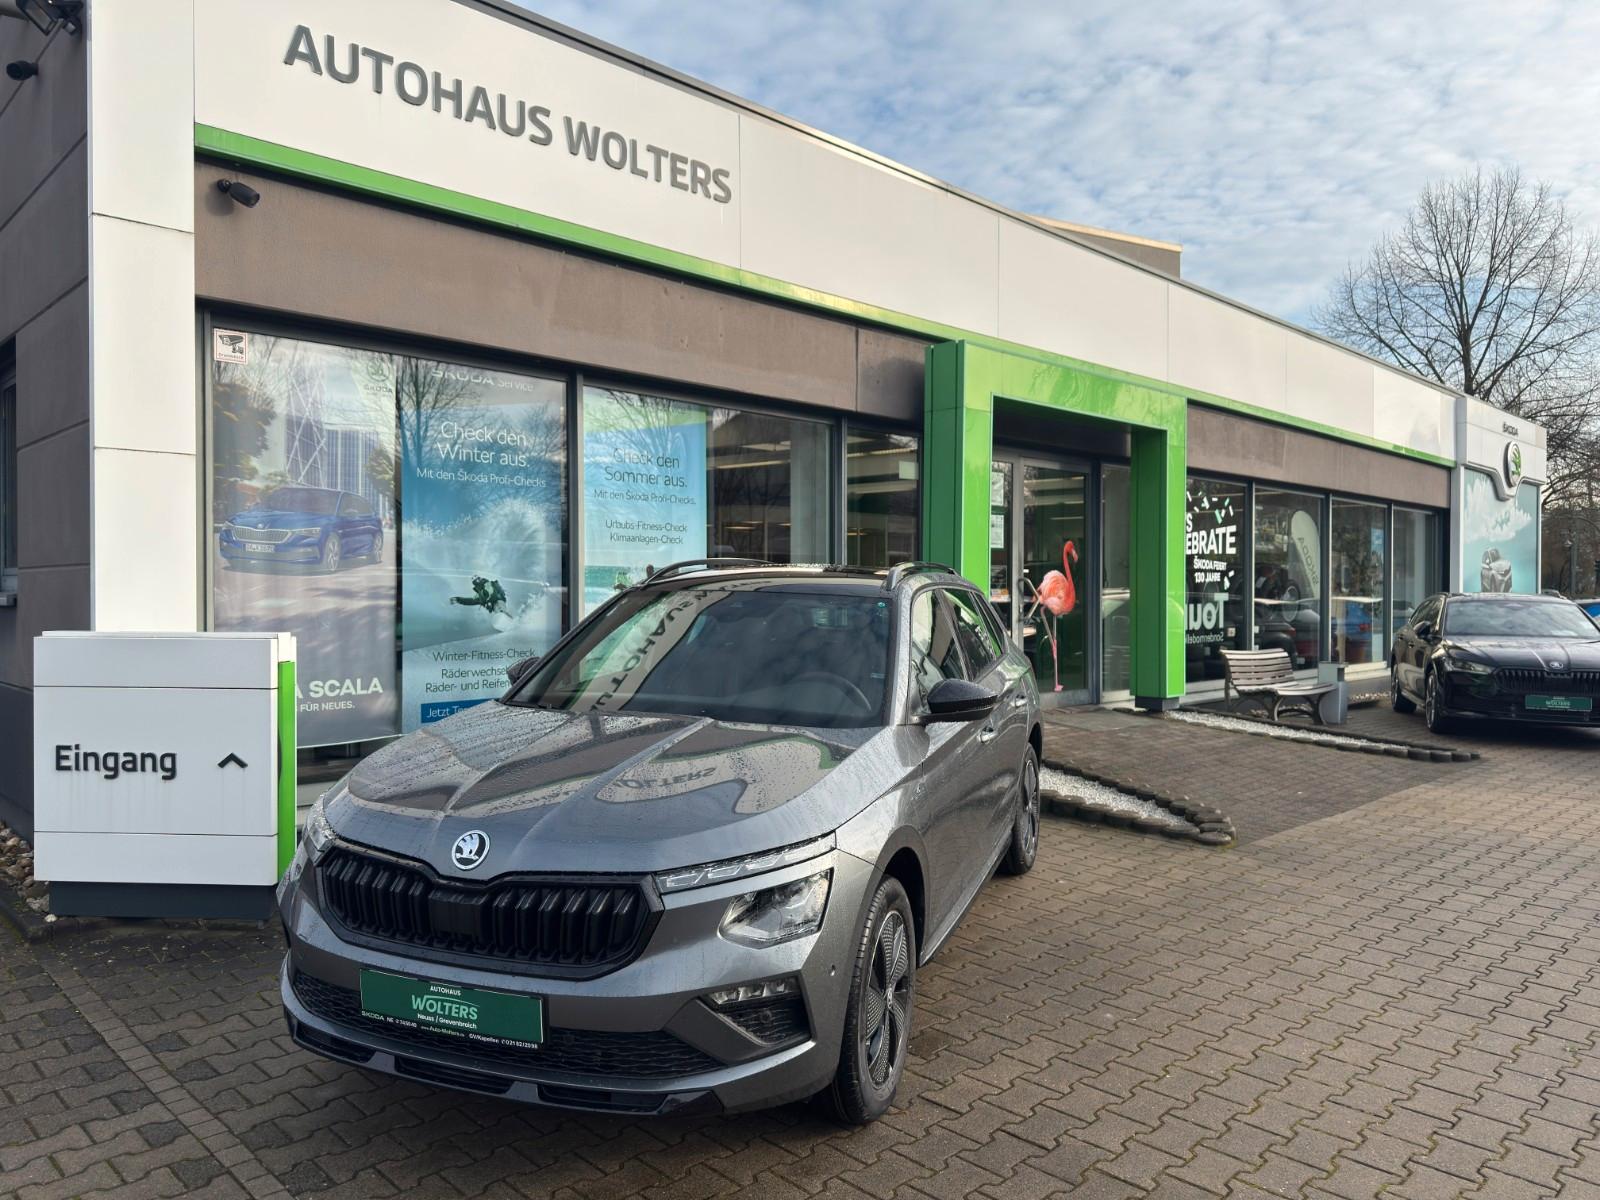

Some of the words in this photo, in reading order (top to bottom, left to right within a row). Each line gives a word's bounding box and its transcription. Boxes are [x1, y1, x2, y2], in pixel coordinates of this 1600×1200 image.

[283, 24, 553, 146] AUTOHAUS
[563, 116, 732, 204] WOLTERS
[441, 421, 493, 443] Check
[497, 429, 527, 447] den
[436, 442, 495, 464] Winter
[499, 452, 530, 468] aus.
[613, 448, 653, 465] Check
[656, 454, 680, 469] den
[416, 467, 434, 479] Mit
[436, 470, 455, 481] den
[457, 468, 489, 483] Škoda
[604, 466, 661, 484] Sommer
[664, 474, 688, 488] aus.
[594, 489, 608, 499] Mit
[609, 490, 625, 500] den
[610, 533, 684, 545] Klimaanlagen-Check
[1186, 525, 1237, 555] EBRATE
[432, 648, 536, 662] Winter-Fitness-Check
[441, 666, 509, 679] Räderwechsel
[309, 677, 384, 698] SCALA
[425, 682, 458, 693] Räder-
[460, 680, 480, 691] und
[300, 701, 320, 713] FÜR
[321, 700, 356, 711] NEUES.
[425, 706, 449, 718] Jetzt
[54, 743, 178, 781] Eingang
[430, 985, 462, 996] AUTOHAUS
[411, 994, 478, 1020] WOLTERS
[439, 1017, 477, 1029] Grevenbroich
